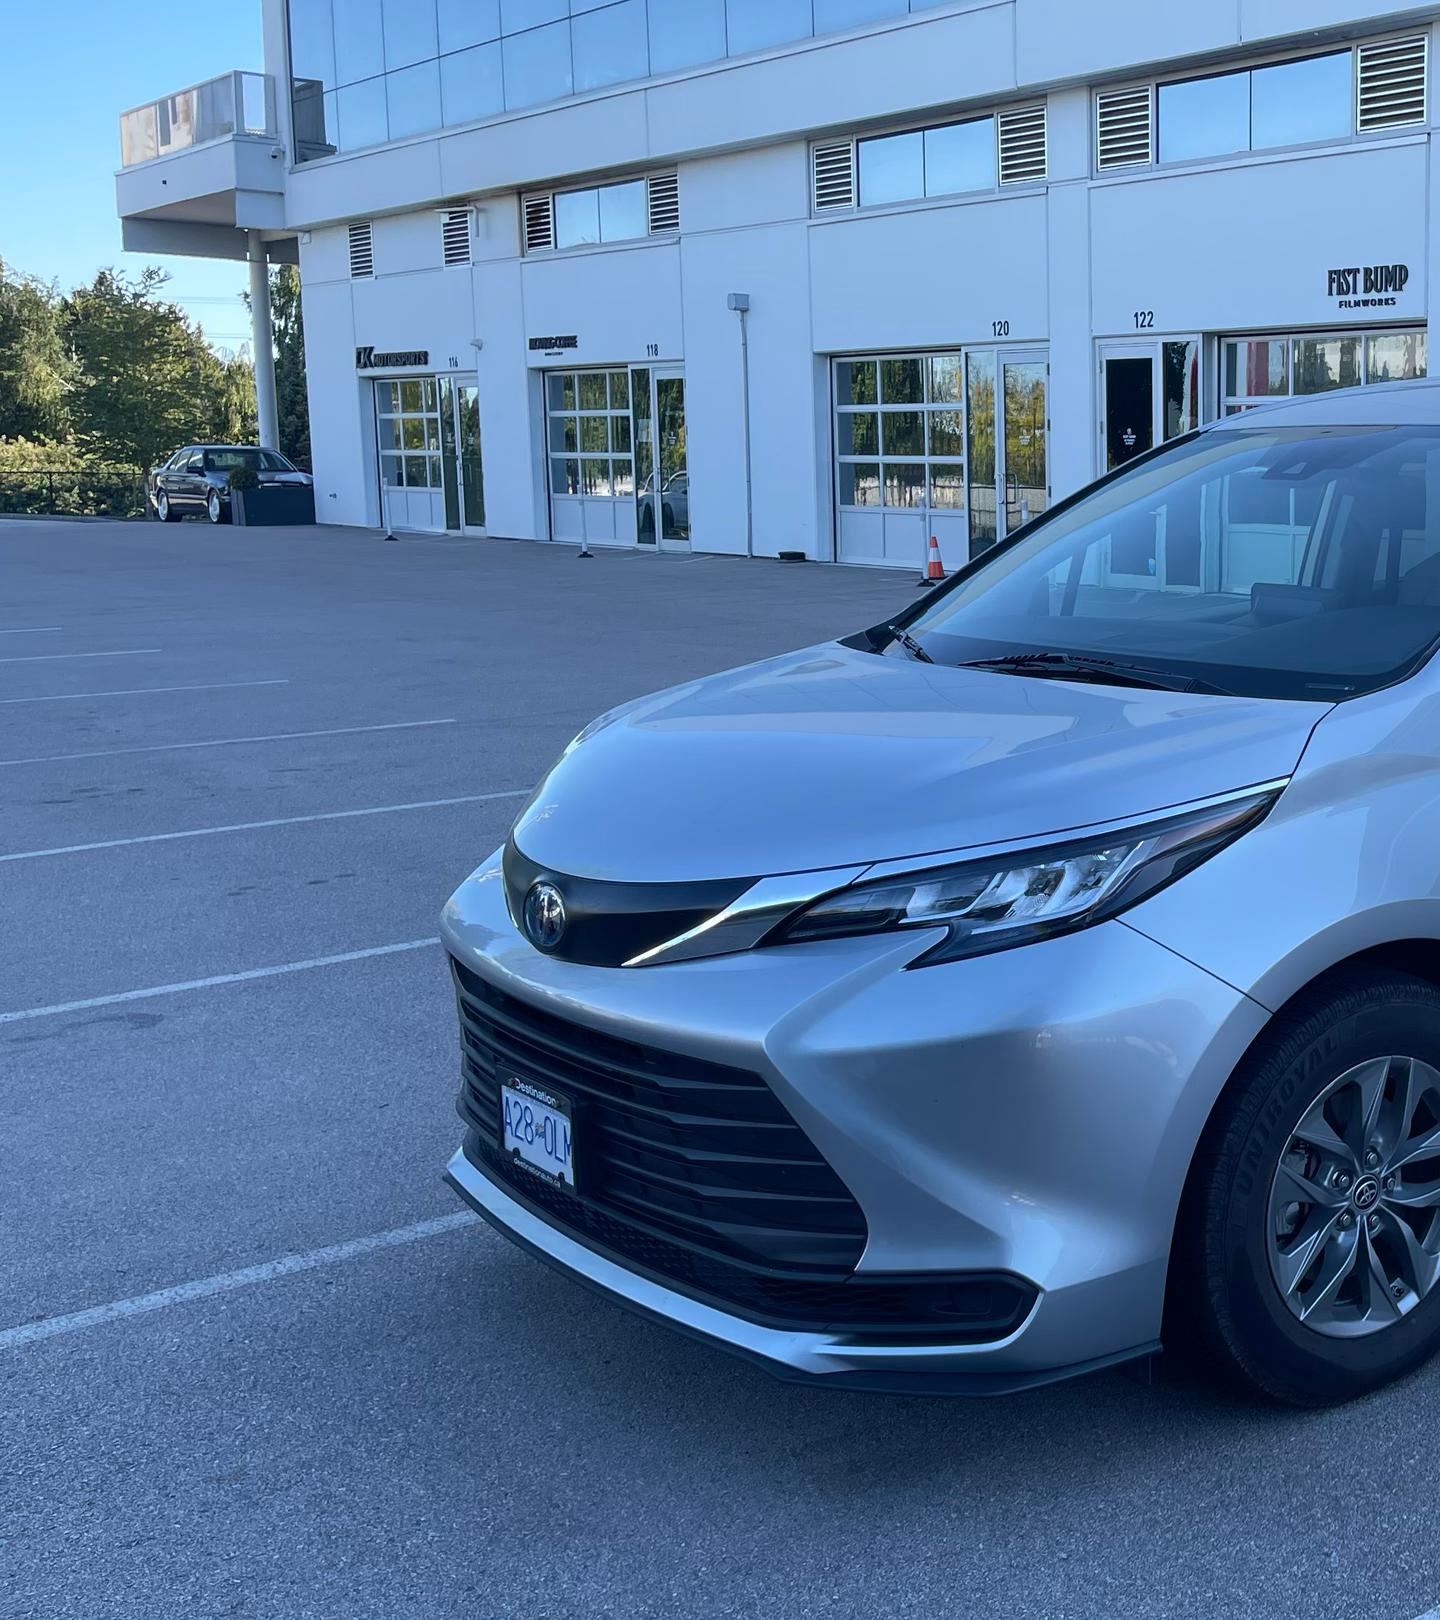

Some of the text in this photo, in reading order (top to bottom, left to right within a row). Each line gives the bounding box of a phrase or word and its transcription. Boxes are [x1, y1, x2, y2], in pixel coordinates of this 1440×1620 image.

[1327, 264, 1408, 296] FIST BUMP
[1338, 297, 1396, 309] FILMWORKS
[1133, 311, 1154, 328] 122
[992, 320, 1009, 337] 120
[646, 344, 659, 357] 118
[504, 1095, 534, 1146] A28
